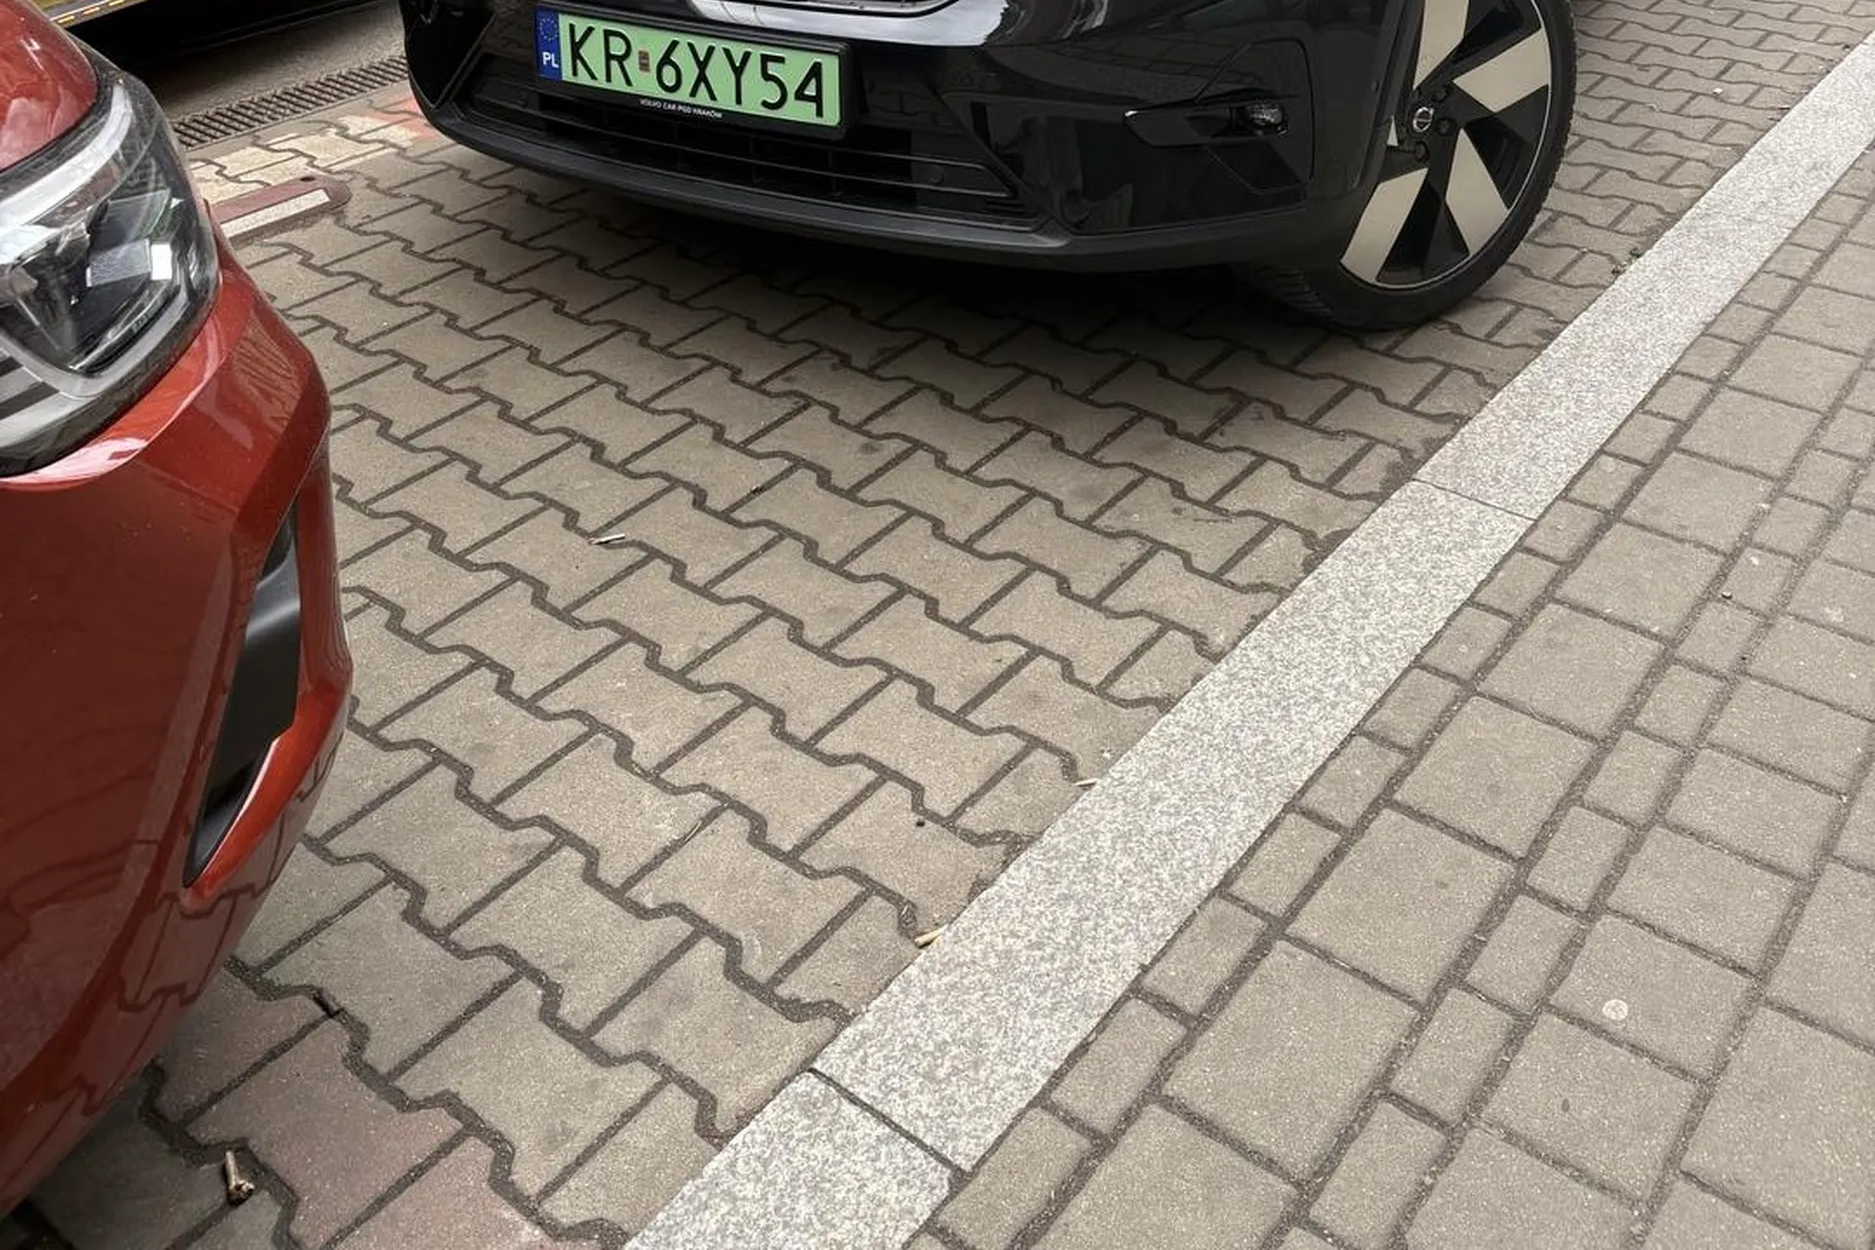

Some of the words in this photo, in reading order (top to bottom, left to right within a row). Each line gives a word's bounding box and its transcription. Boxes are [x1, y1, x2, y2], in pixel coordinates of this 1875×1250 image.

[542, 52, 559, 68] PL
[568, 23, 634, 88] KR
[655, 39, 825, 119] 6XY54
